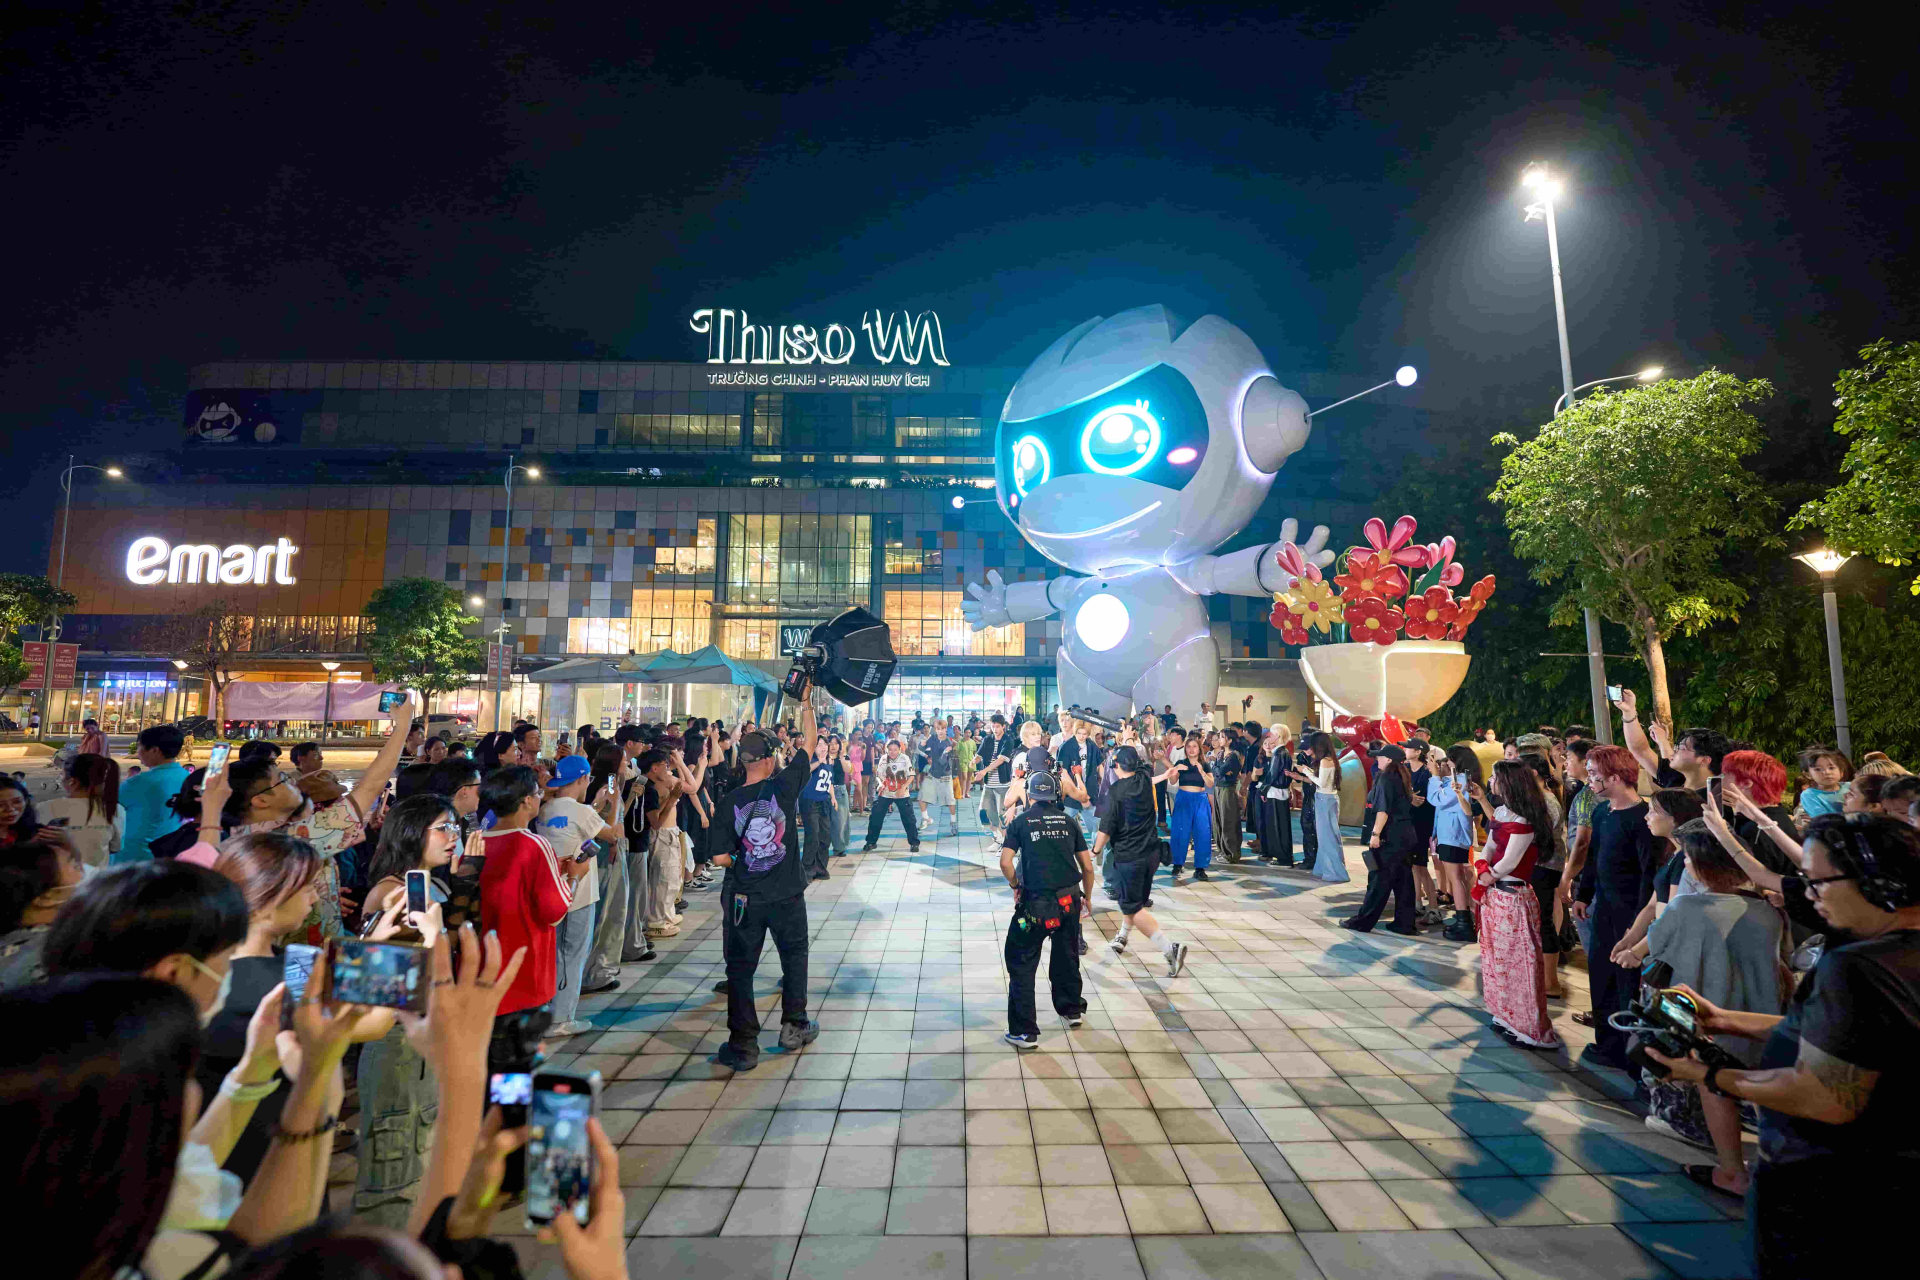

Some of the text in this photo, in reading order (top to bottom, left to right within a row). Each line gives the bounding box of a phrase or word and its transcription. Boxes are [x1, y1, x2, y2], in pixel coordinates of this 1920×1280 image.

[707, 370, 768, 386] TRƯỜNG
[771, 373, 817, 386] CHINH
[828, 374, 869, 387] PHAN
[872, 374, 903, 387] HUY
[905, 371, 930, 387] ÍCH
[126, 536, 299, 585] emart
